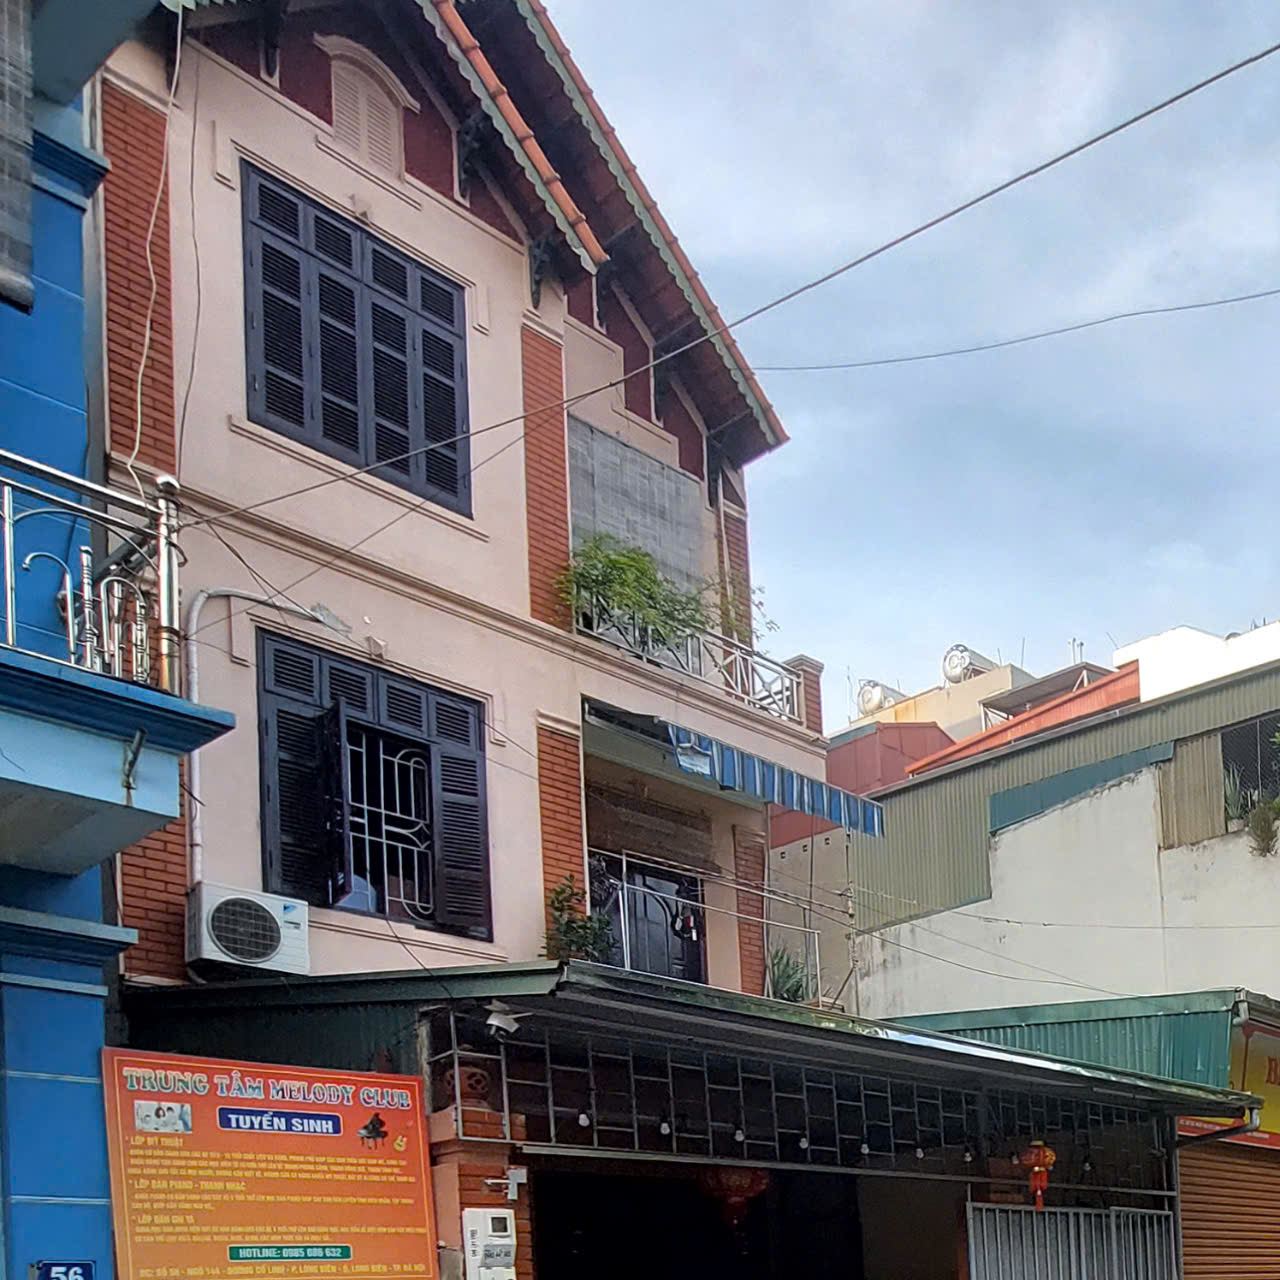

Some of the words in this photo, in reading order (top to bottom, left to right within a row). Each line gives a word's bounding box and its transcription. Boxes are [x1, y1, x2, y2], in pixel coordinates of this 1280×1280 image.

[123, 1067, 209, 1095] TRUNG
[214, 1070, 264, 1099] TÂM
[270, 1079, 354, 1105] MELODY
[360, 1088, 411, 1109] CLUB
[228, 1111, 286, 1131] TUYỂN
[292, 1118, 333, 1133] SINH
